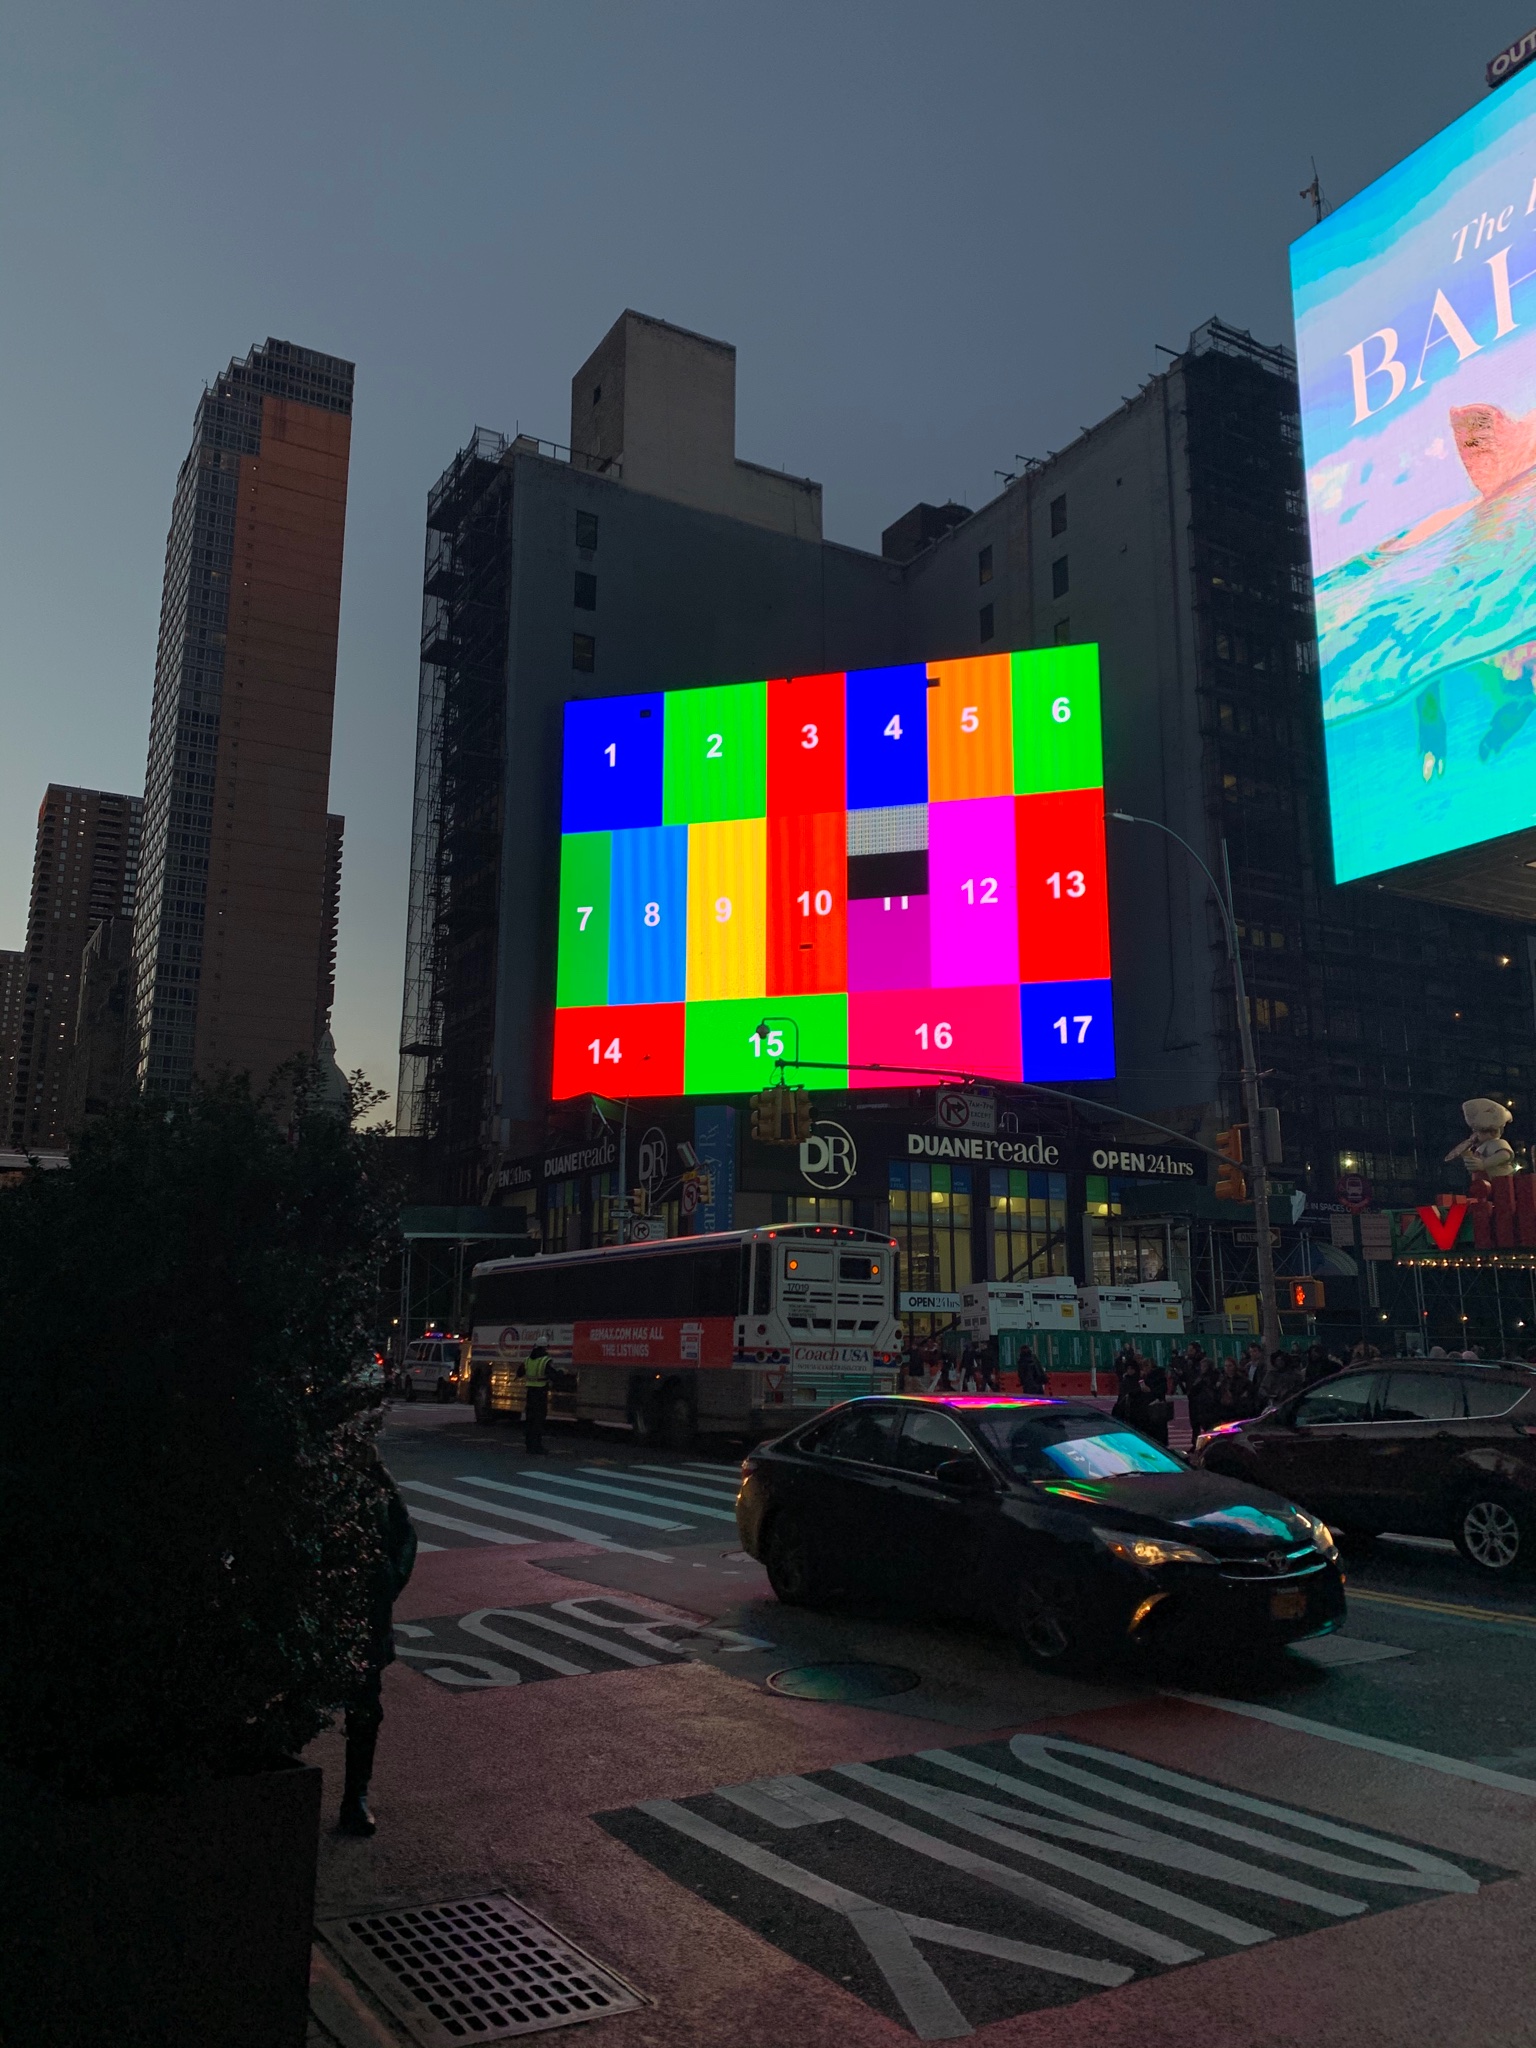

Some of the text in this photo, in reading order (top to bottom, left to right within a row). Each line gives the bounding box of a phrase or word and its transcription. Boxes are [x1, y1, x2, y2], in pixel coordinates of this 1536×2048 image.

[1452, 205, 1514, 264] The
[961, 706, 979, 733] 5
[1053, 697, 1071, 723] 6
[801, 724, 819, 749] 3
[884, 714, 903, 740] 4
[604, 743, 616, 767] 1
[706, 733, 723, 758] 2
[961, 877, 998, 905] 12
[1047, 870, 1086, 899] 13
[644, 902, 661, 927] 8
[715, 897, 732, 923] 9
[797, 889, 832, 917] 10
[577, 906, 593, 931] 7
[915, 1022, 953, 1050] 16
[1053, 1015, 1093, 1044] 17
[588, 1037, 622, 1064] 14
[749, 1030, 784, 1057] 15
[970, 1111, 992, 1119] EXCEPT
[971, 1120, 991, 1129] BUSES
[638, 1140, 668, 1181] DR
[799, 1135, 858, 1176] DR
[1092, 1149, 1146, 1172] OPEN
[1240, 1233, 1256, 1241] ONE
[787, 1283, 810, 1292] 17019
[908, 1296, 936, 1307] OPEN
[648, 1326, 664, 1340] ALL
[601, 1343, 650, 1357] THE LISTINGS
[795, 1346, 869, 1363] Coach USA
[633, 1733, 1481, 2041] ONLY
